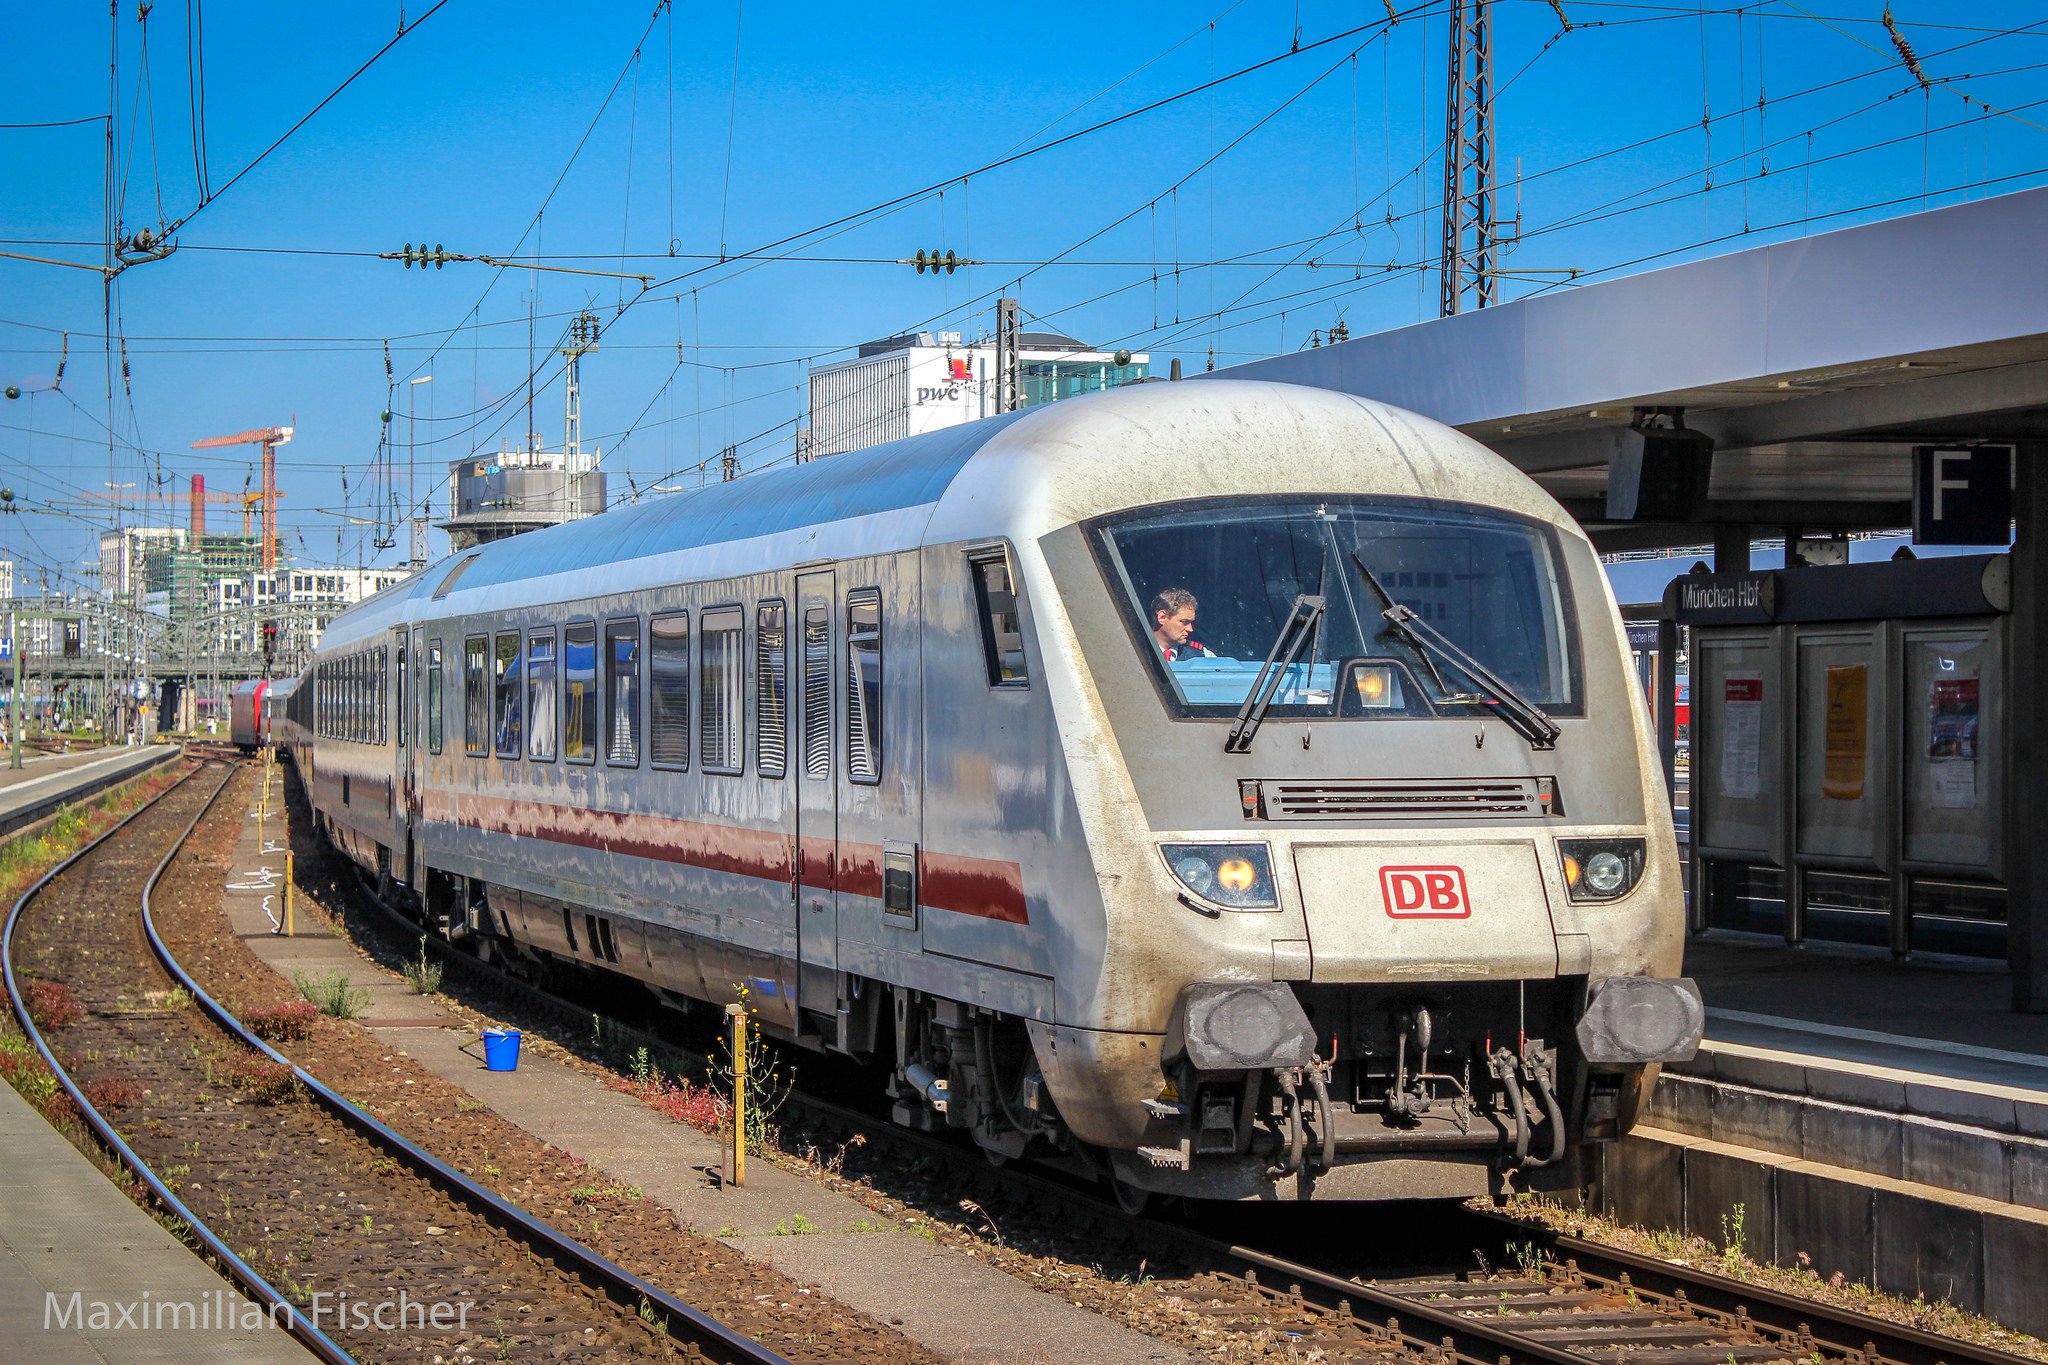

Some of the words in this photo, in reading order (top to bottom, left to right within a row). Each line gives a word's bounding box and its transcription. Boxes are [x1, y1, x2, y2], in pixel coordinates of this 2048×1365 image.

[916, 387, 958, 406] pwc
[1933, 450, 1971, 520] F
[1682, 582, 1735, 609] München
[1738, 580, 1760, 607] Hbf
[68, 628, 77, 639] 11
[1647, 630, 1658, 643] Hbf
[1391, 874, 1459, 910] DB
